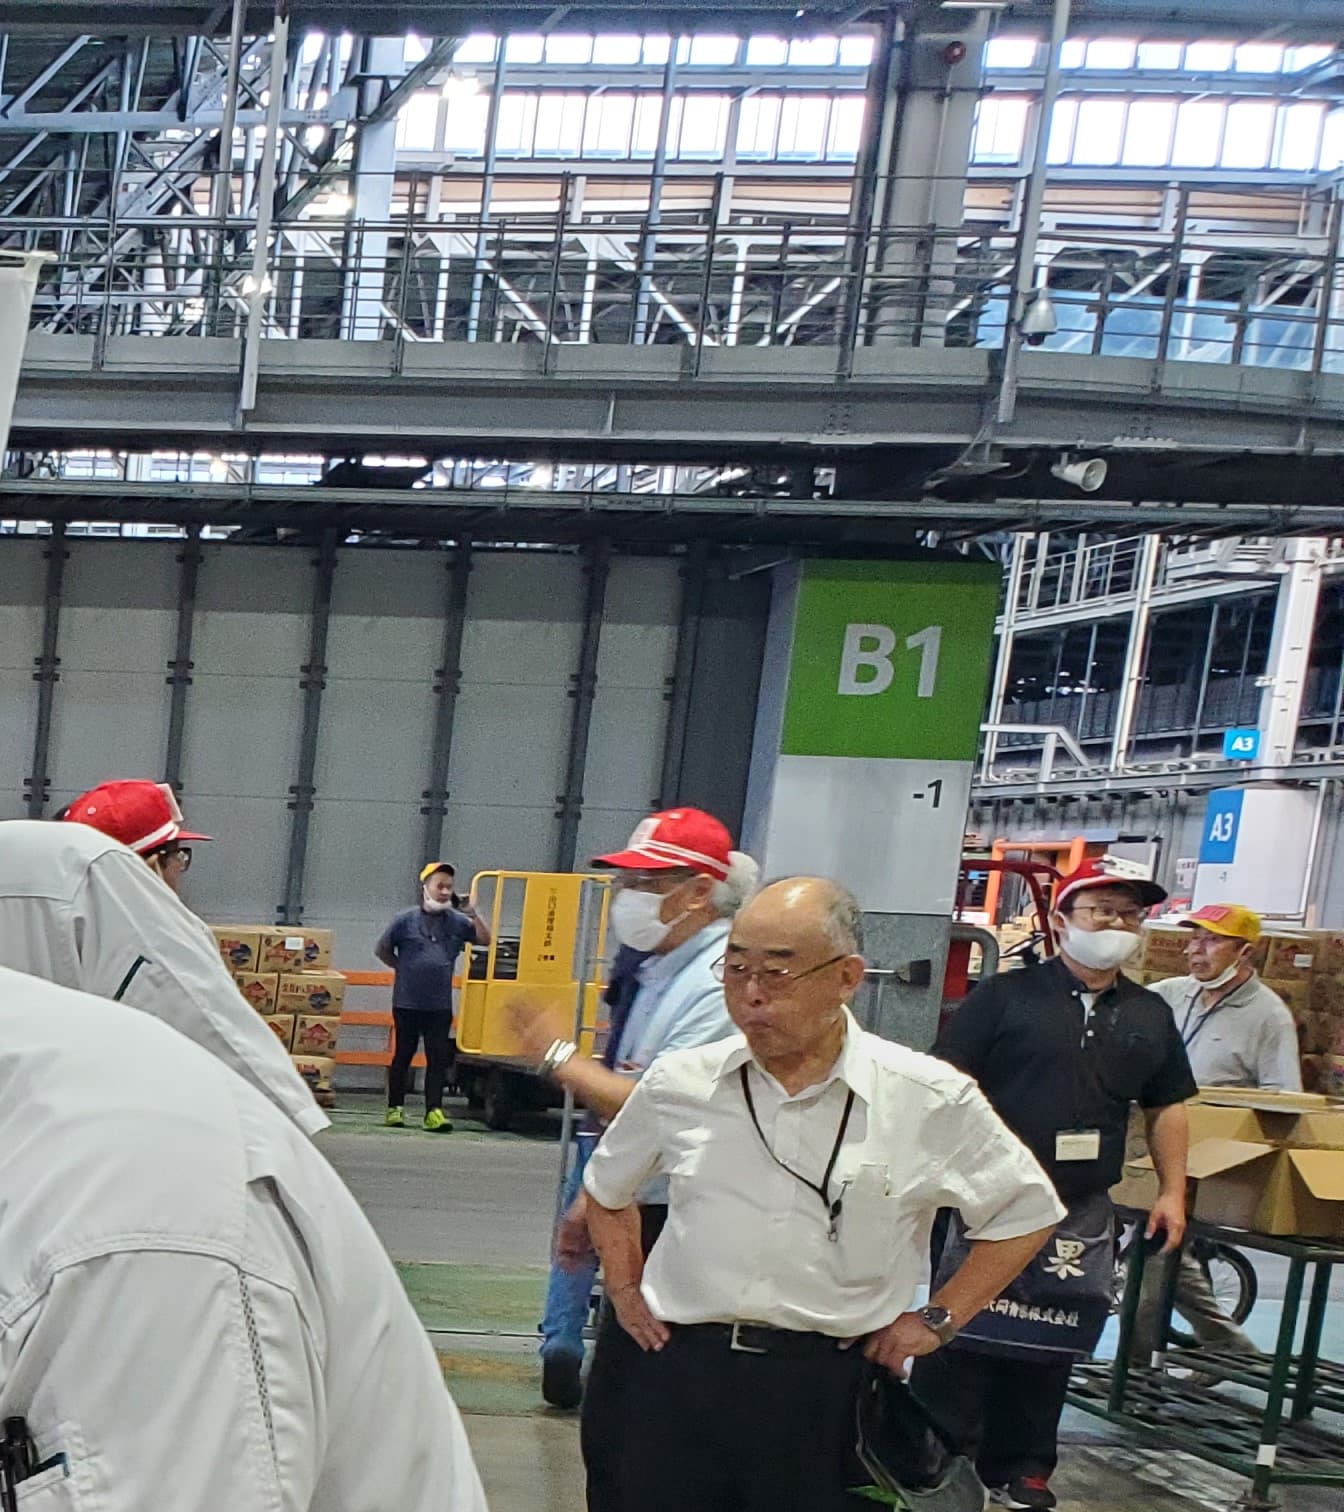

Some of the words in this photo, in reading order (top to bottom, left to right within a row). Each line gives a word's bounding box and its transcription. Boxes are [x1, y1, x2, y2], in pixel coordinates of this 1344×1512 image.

[837, 623, 942, 698] B1
[1231, 736, 1254, 752] A3
[912, 778, 943, 809] -1
[1209, 812, 1234, 842] A3
[1043, 1238, 1086, 1281] 果
